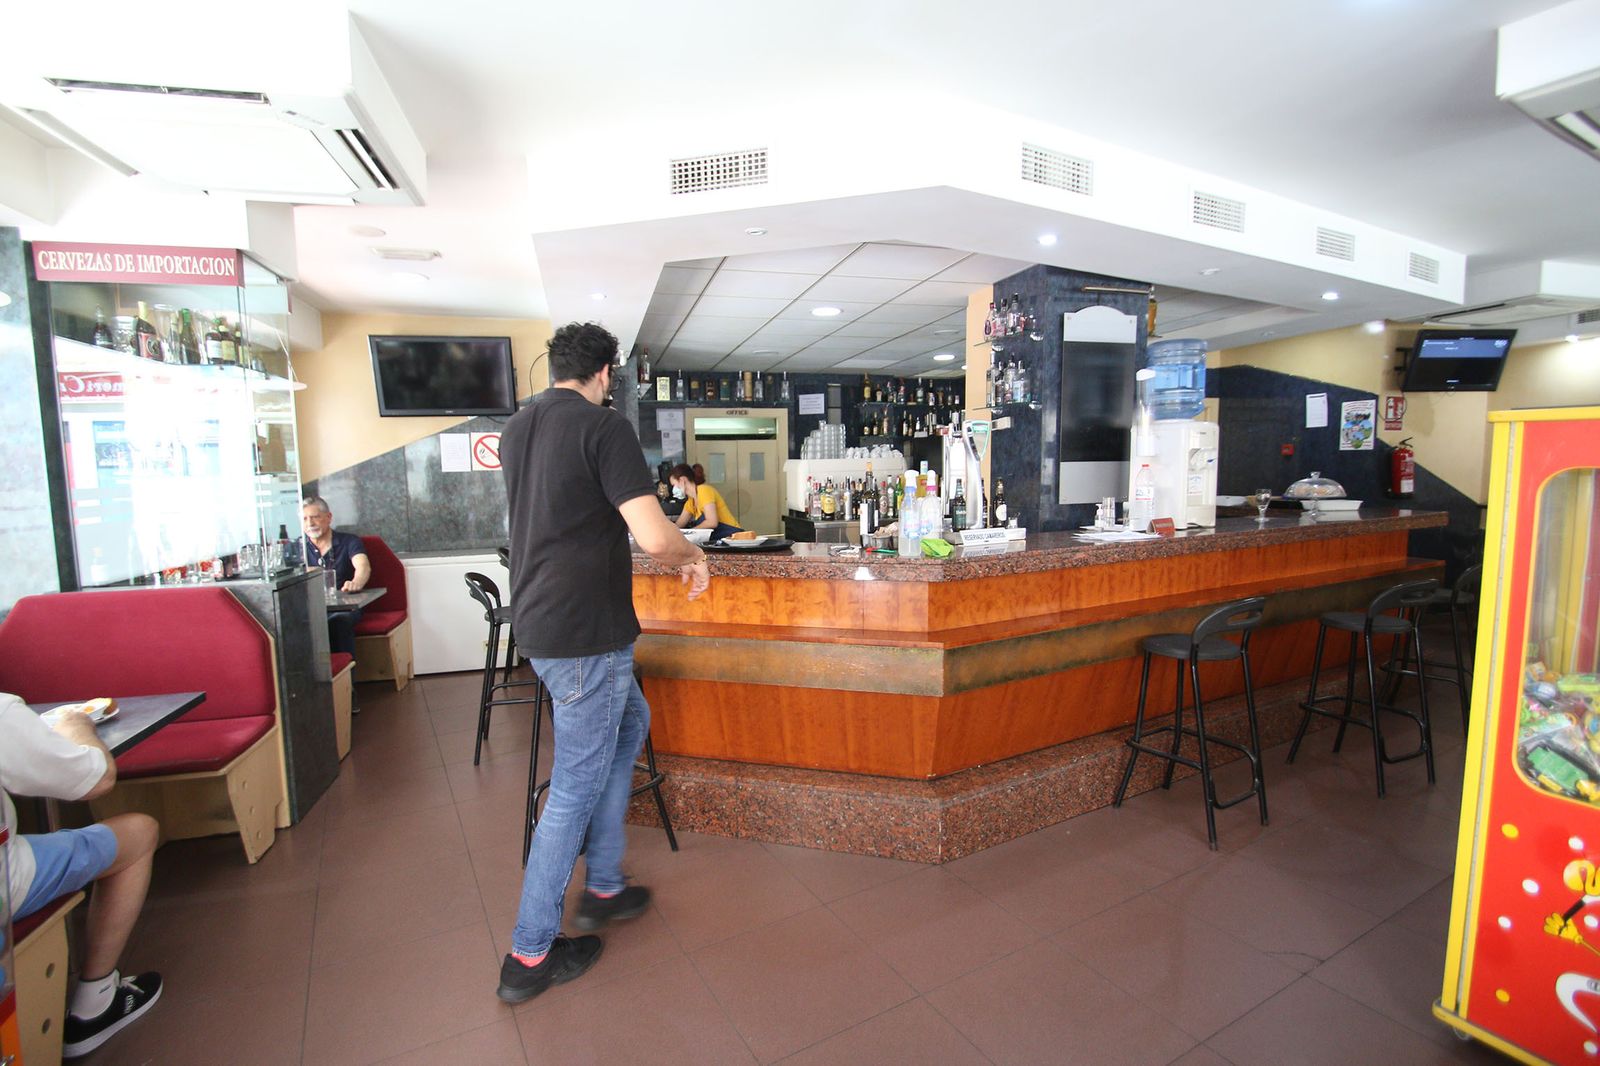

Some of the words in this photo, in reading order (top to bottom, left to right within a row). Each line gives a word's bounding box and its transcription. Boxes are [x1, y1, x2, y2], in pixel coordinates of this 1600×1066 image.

[38, 251, 112, 272] CERVEZAS
[114, 254, 135, 272] DE
[138, 255, 235, 276] IMPORTACION
